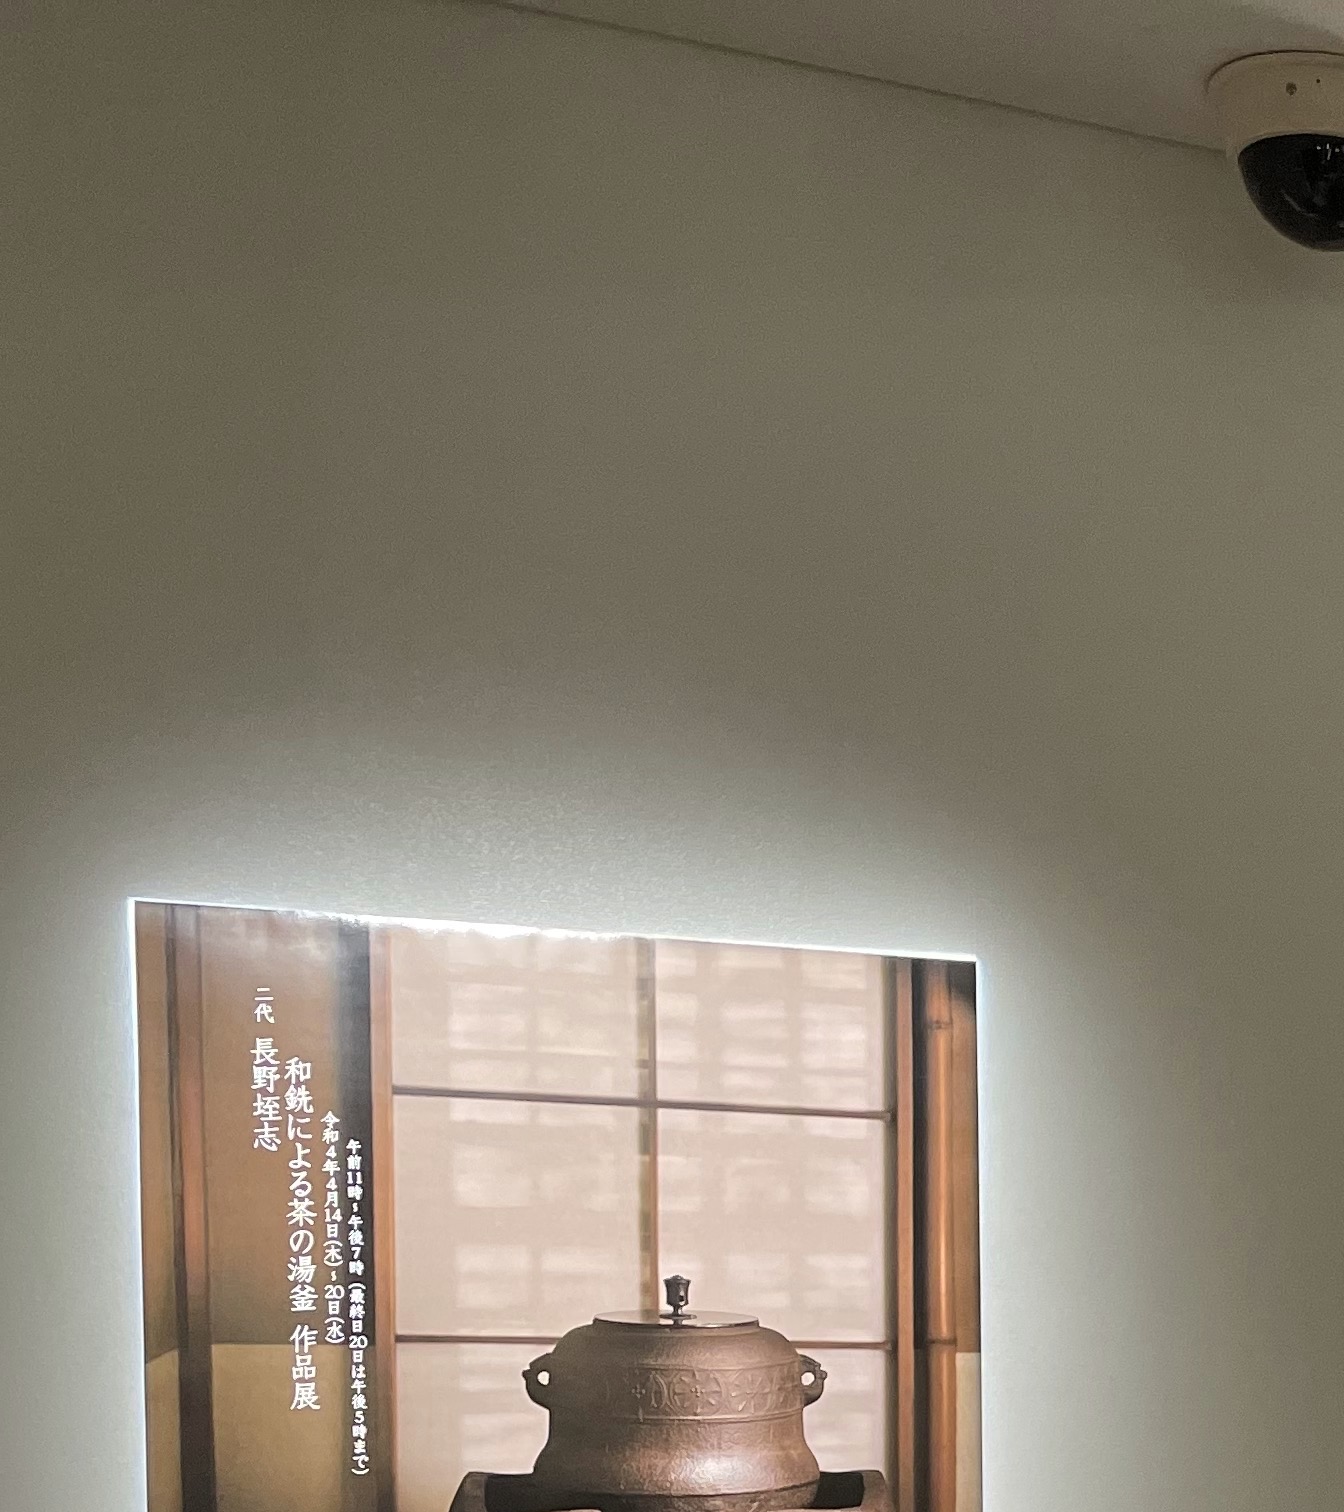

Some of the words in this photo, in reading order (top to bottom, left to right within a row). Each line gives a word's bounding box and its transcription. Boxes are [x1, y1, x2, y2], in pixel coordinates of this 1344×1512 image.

[254, 987, 276, 1024] 二代
[250, 1037, 282, 1152] 長野垤志
[283, 1056, 319, 1312] 和銑による茶の湯釜
[289, 1324, 321, 1411] 作品展
